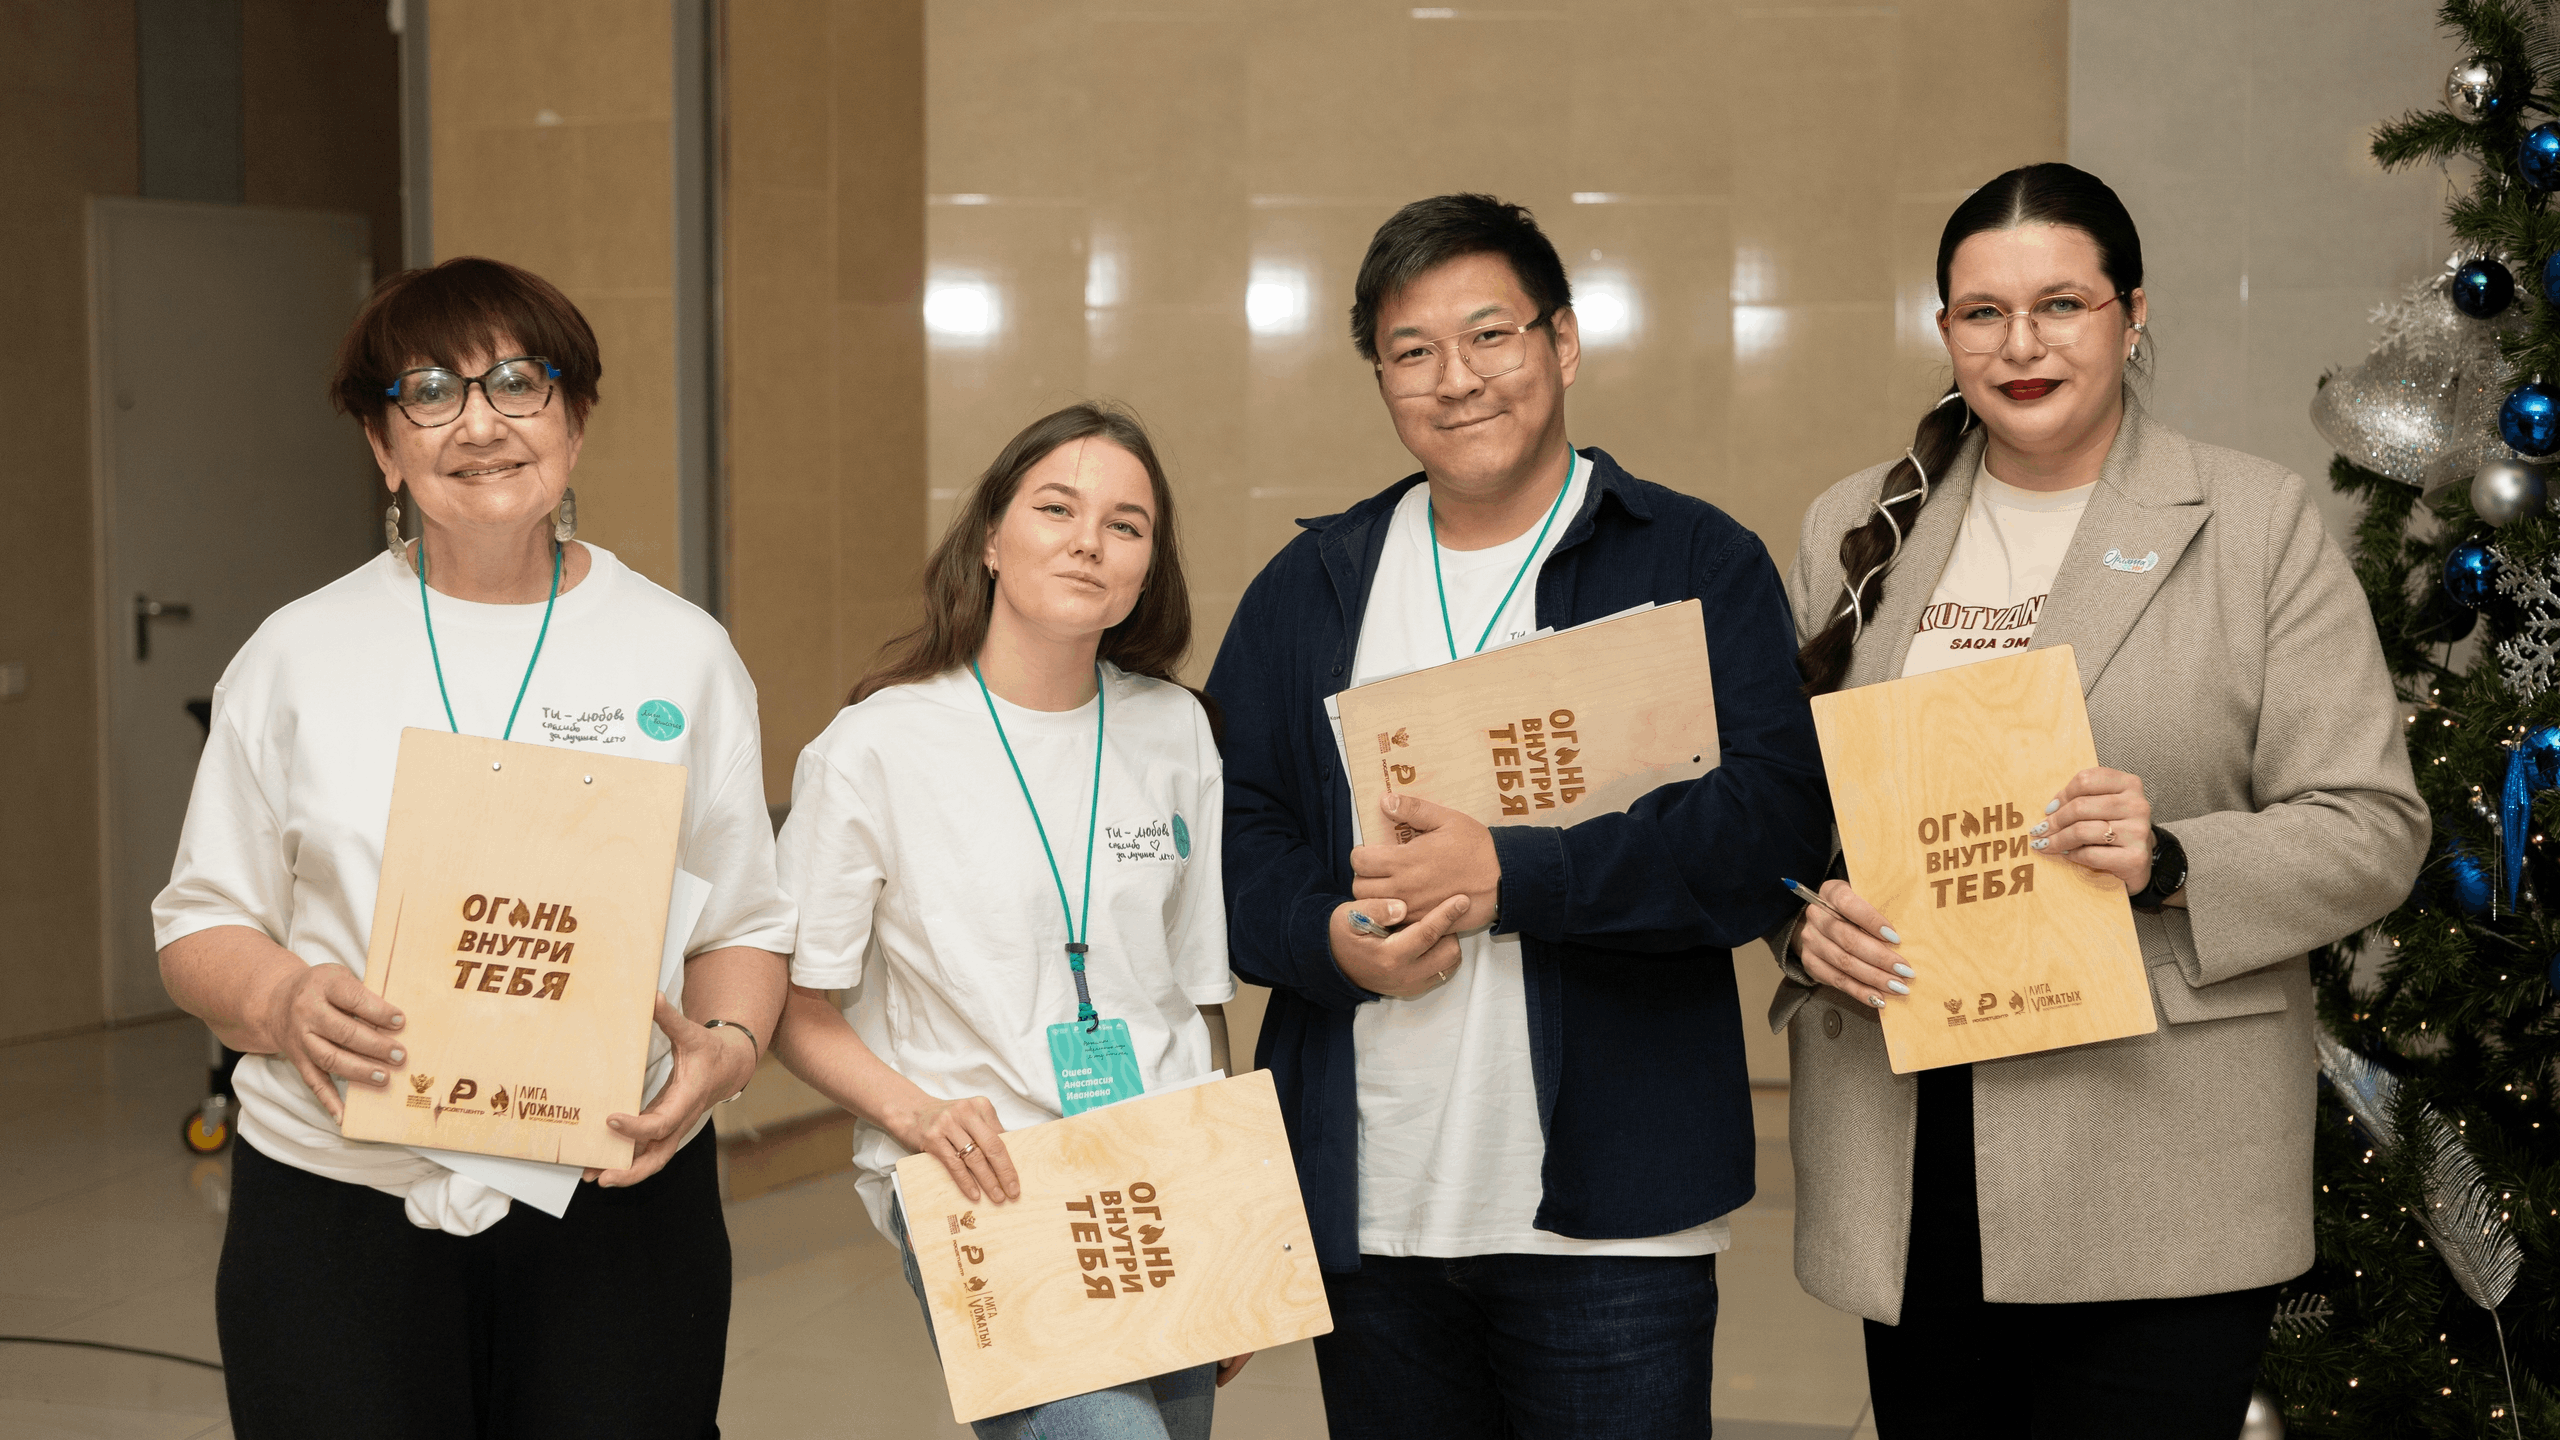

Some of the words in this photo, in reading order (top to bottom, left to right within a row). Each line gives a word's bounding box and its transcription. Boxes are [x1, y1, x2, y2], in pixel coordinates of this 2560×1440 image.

[1914, 594, 2048, 634] KUTYAN
[1950, 638, 1997, 649] SAQA
[576, 706, 625, 723] любовь
[542, 721, 581, 733] спасибо
[549, 732, 561, 742] за
[602, 735, 626, 743] лето
[1489, 723, 1529, 816] ТЕБЯ
[1521, 718, 1555, 809] ВНУТРИ
[1382, 759, 1392, 793] РОСДЕТЦЕНТ
[1134, 820, 1170, 838] любовь
[1108, 839, 1141, 850] спасибо
[1926, 834, 2028, 874] ВНУТРИ
[1116, 852, 1126, 863] за
[1159, 853, 1175, 861] лето
[1930, 863, 2034, 909] ТЕБЯ
[457, 930, 575, 964] ВНУТРИ
[454, 960, 570, 1001] ТЕБЯ
[2029, 983, 2051, 996] ЛИГА
[1064, 1076, 1114, 1089] Анастасия
[519, 1085, 548, 1101] ЛИГА
[1066, 1088, 1111, 1101] Ивановна
[1065, 1195, 1116, 1299] ТЕБЯ
[1099, 1191, 1144, 1293] ВНУТРИ
[984, 1296, 998, 1319] ЛИГА
